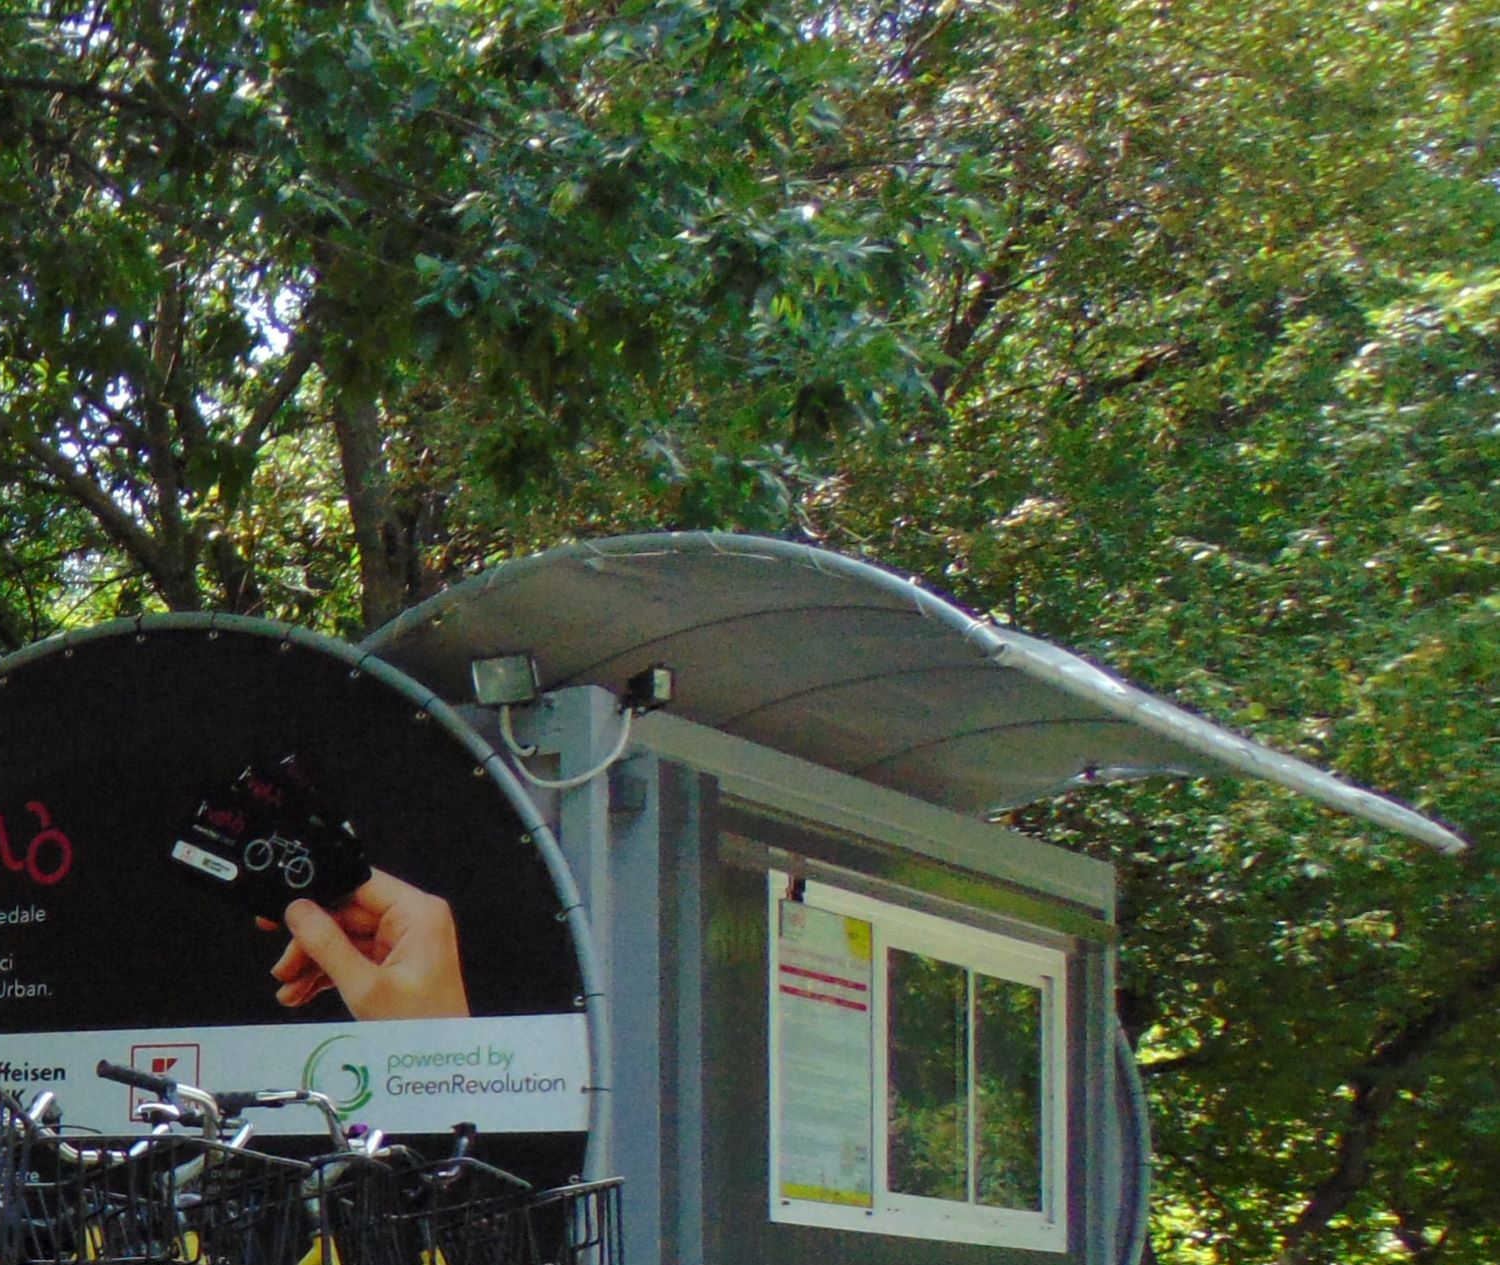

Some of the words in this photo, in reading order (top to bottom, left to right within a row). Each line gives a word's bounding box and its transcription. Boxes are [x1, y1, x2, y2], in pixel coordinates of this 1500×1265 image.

[387, 1045, 481, 1073] powered
[488, 1045, 514, 1071] by
[386, 1073, 566, 1096] GreenRevolution
